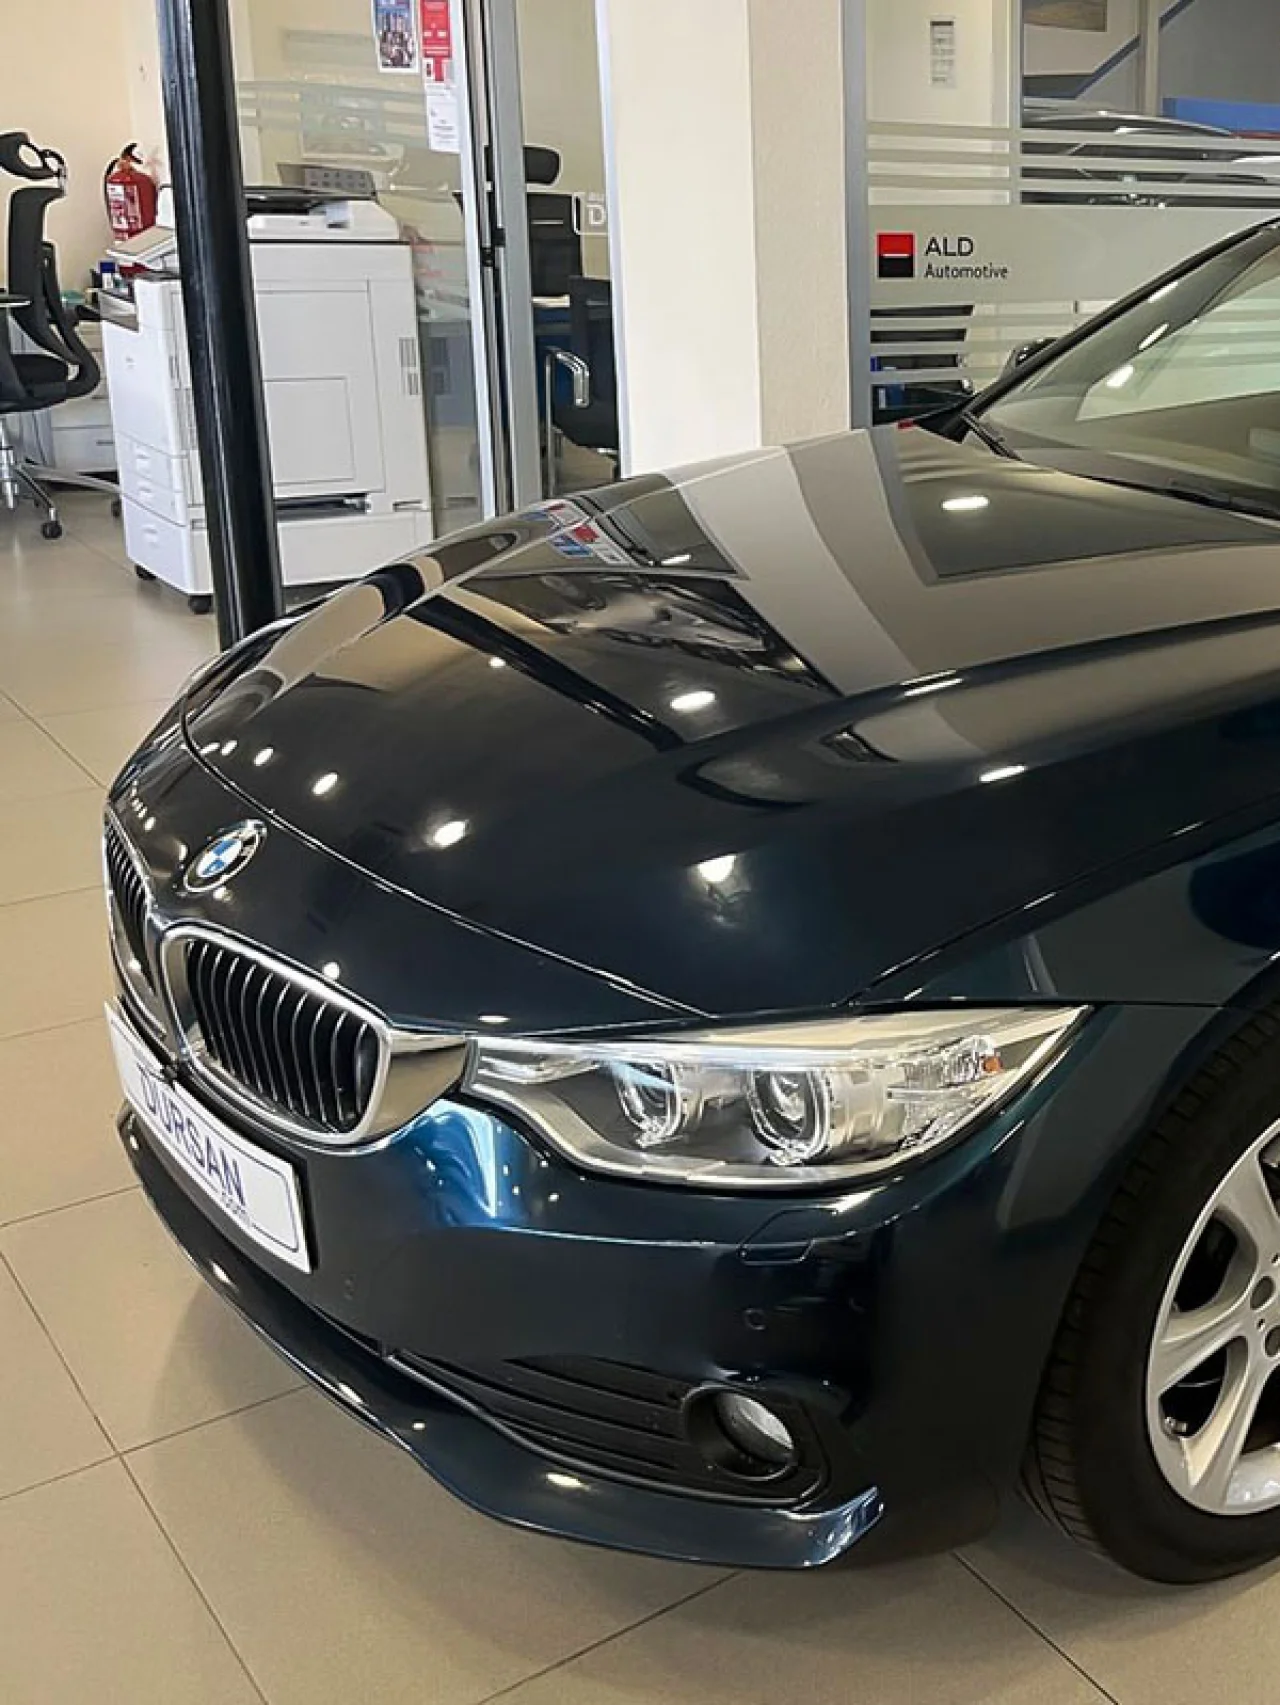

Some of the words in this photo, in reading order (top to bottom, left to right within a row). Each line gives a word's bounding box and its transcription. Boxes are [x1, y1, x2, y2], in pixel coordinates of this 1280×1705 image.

[925, 236, 974, 257] ALD
[924, 262, 1009, 279] Automotive
[137, 1062, 246, 1207] DURSAN
